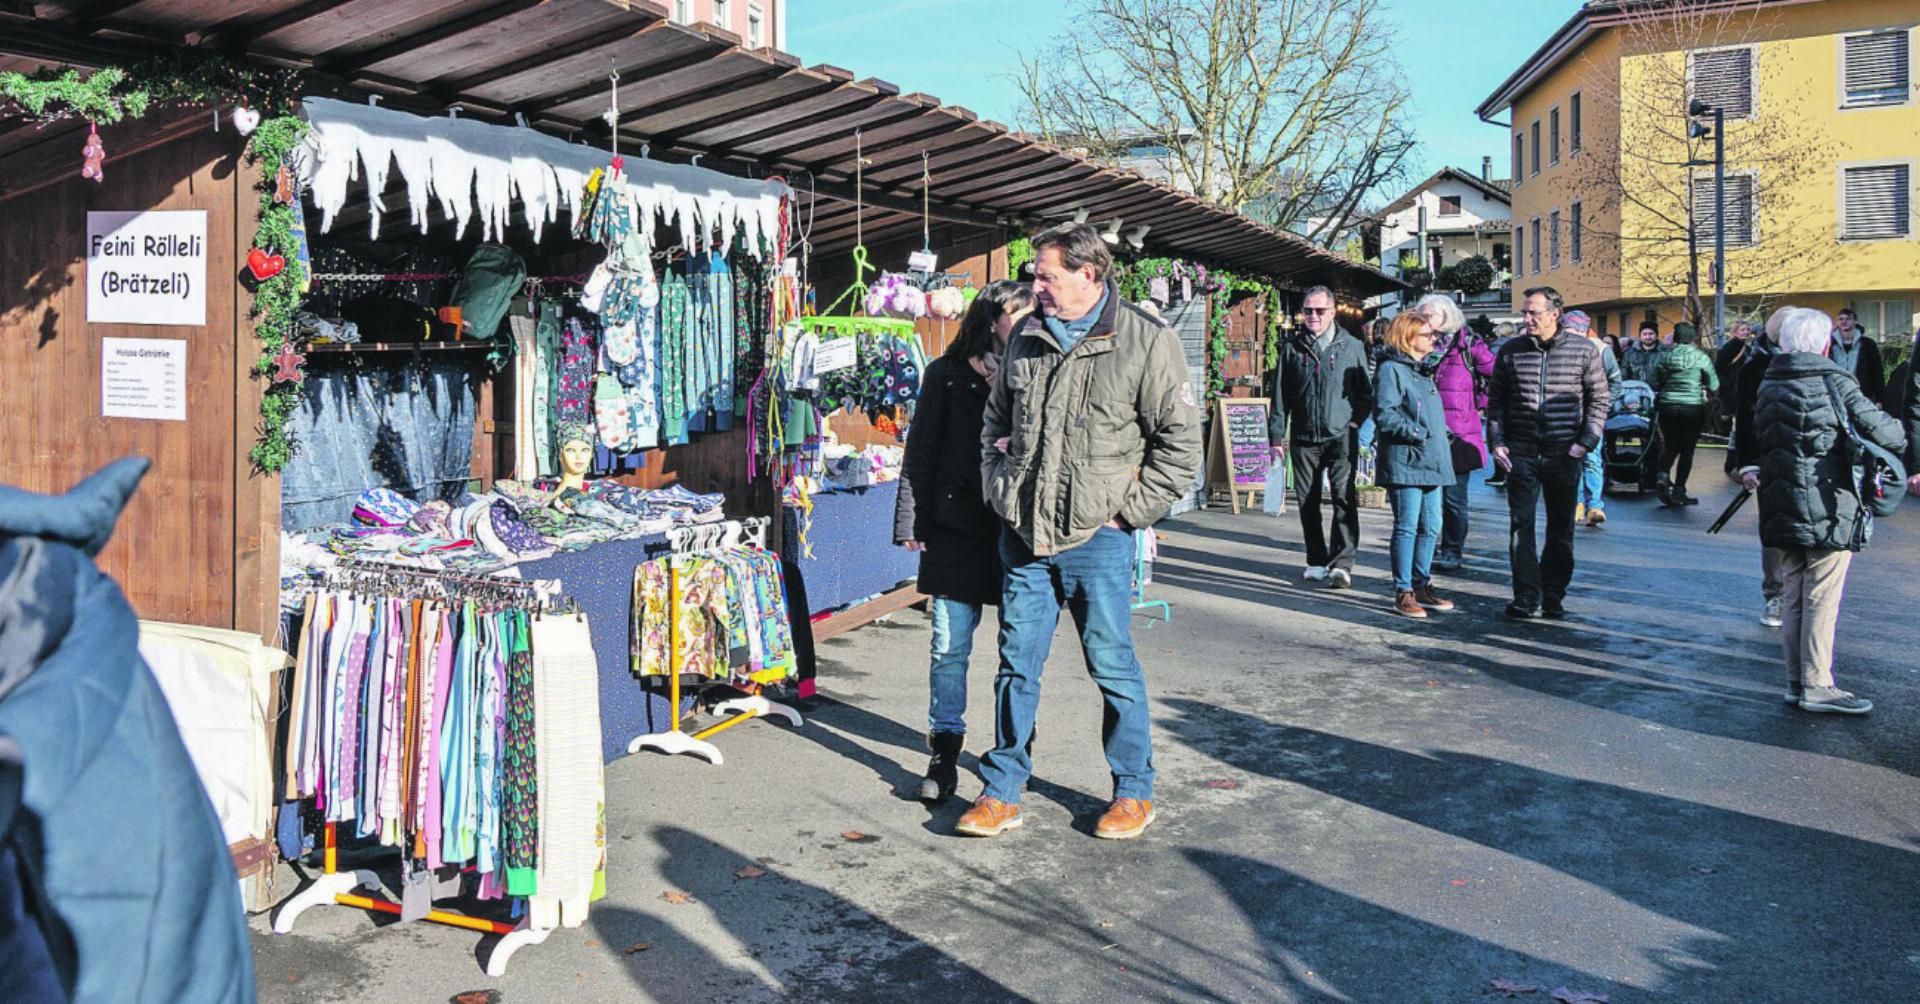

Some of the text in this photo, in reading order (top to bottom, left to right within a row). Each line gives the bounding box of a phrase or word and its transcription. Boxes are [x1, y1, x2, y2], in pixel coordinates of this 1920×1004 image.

[92, 234, 201, 257] Feini Rölleli
[101, 270, 190, 300] (Brätzeli)
